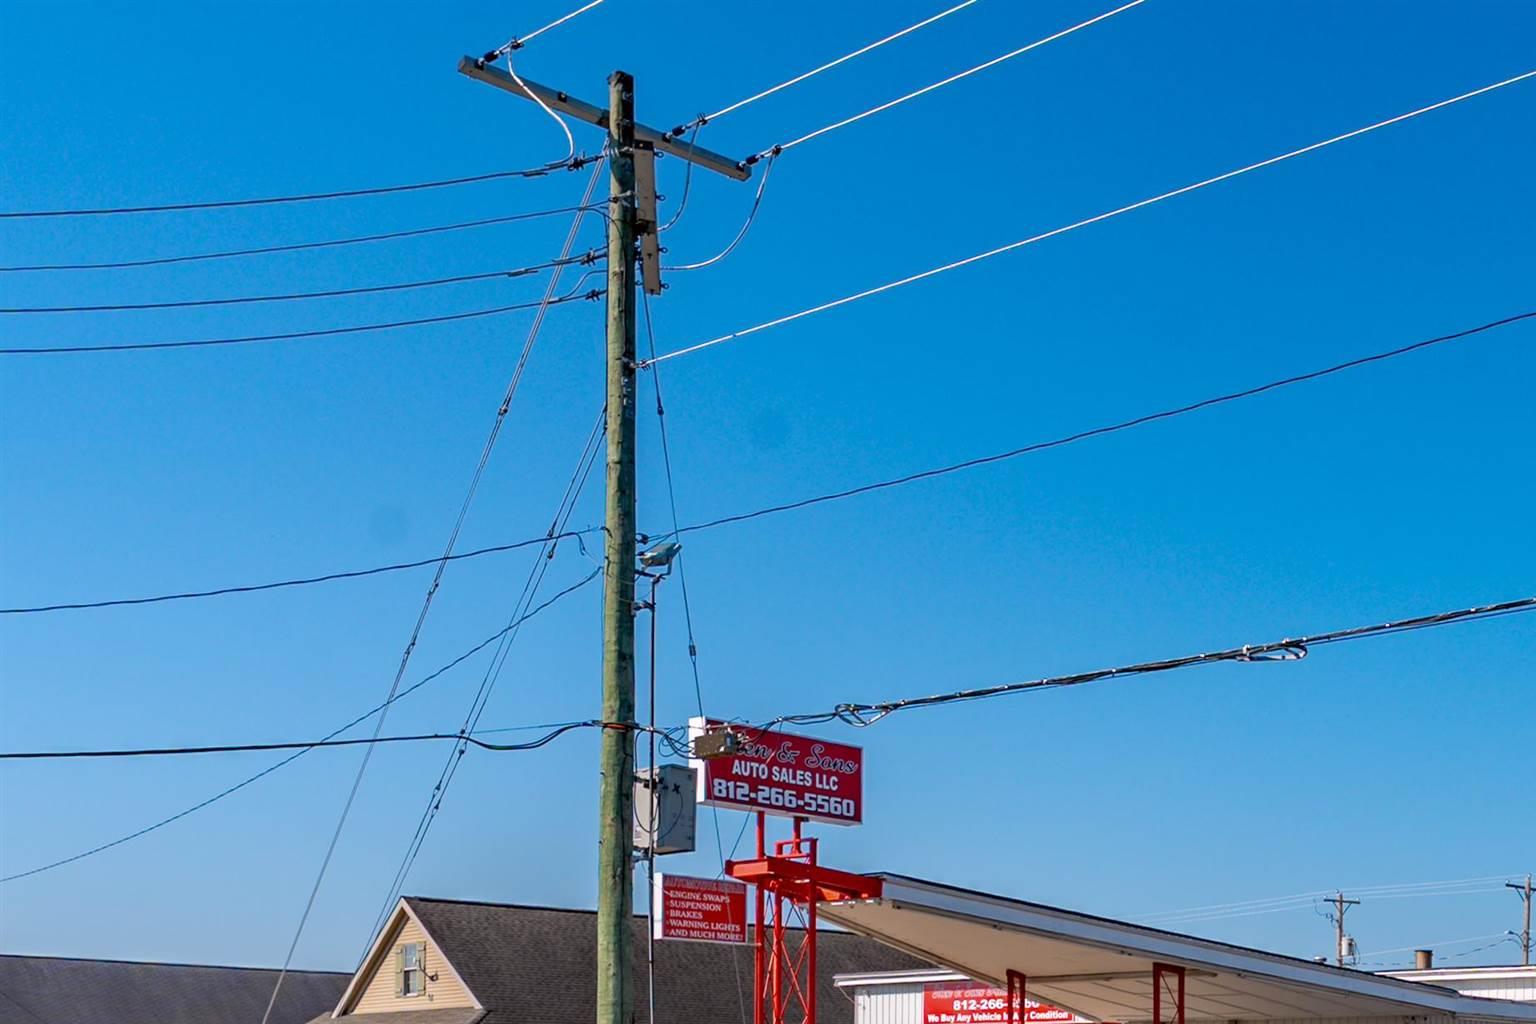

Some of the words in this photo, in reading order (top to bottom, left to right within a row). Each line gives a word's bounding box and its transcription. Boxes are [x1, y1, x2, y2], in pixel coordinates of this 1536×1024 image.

[776, 741, 800, 765] &
[805, 744, 858, 774] Sons
[732, 760, 768, 780] AUTO
[772, 765, 812, 787] SALES
[815, 773, 839, 791] LLC
[713, 778, 855, 817] 812-266-5560
[669, 890, 702, 900] ENGINE
[703, 893, 730, 903] SWAPS
[669, 900, 721, 911] SUSPENSION
[669, 909, 703, 919] BRAKES
[669, 919, 709, 930] WARNING
[711, 922, 741, 932] LIGHTS
[669, 928, 688, 937] AND
[692, 930, 715, 939] MUCH
[928, 1013, 939, 1022] We
[940, 1012, 955, 1023] Buy
[957, 1012, 970, 1023] Any
[973, 1011, 1001, 1021] Vehicle
[1030, 1010, 1068, 1020] Condition
